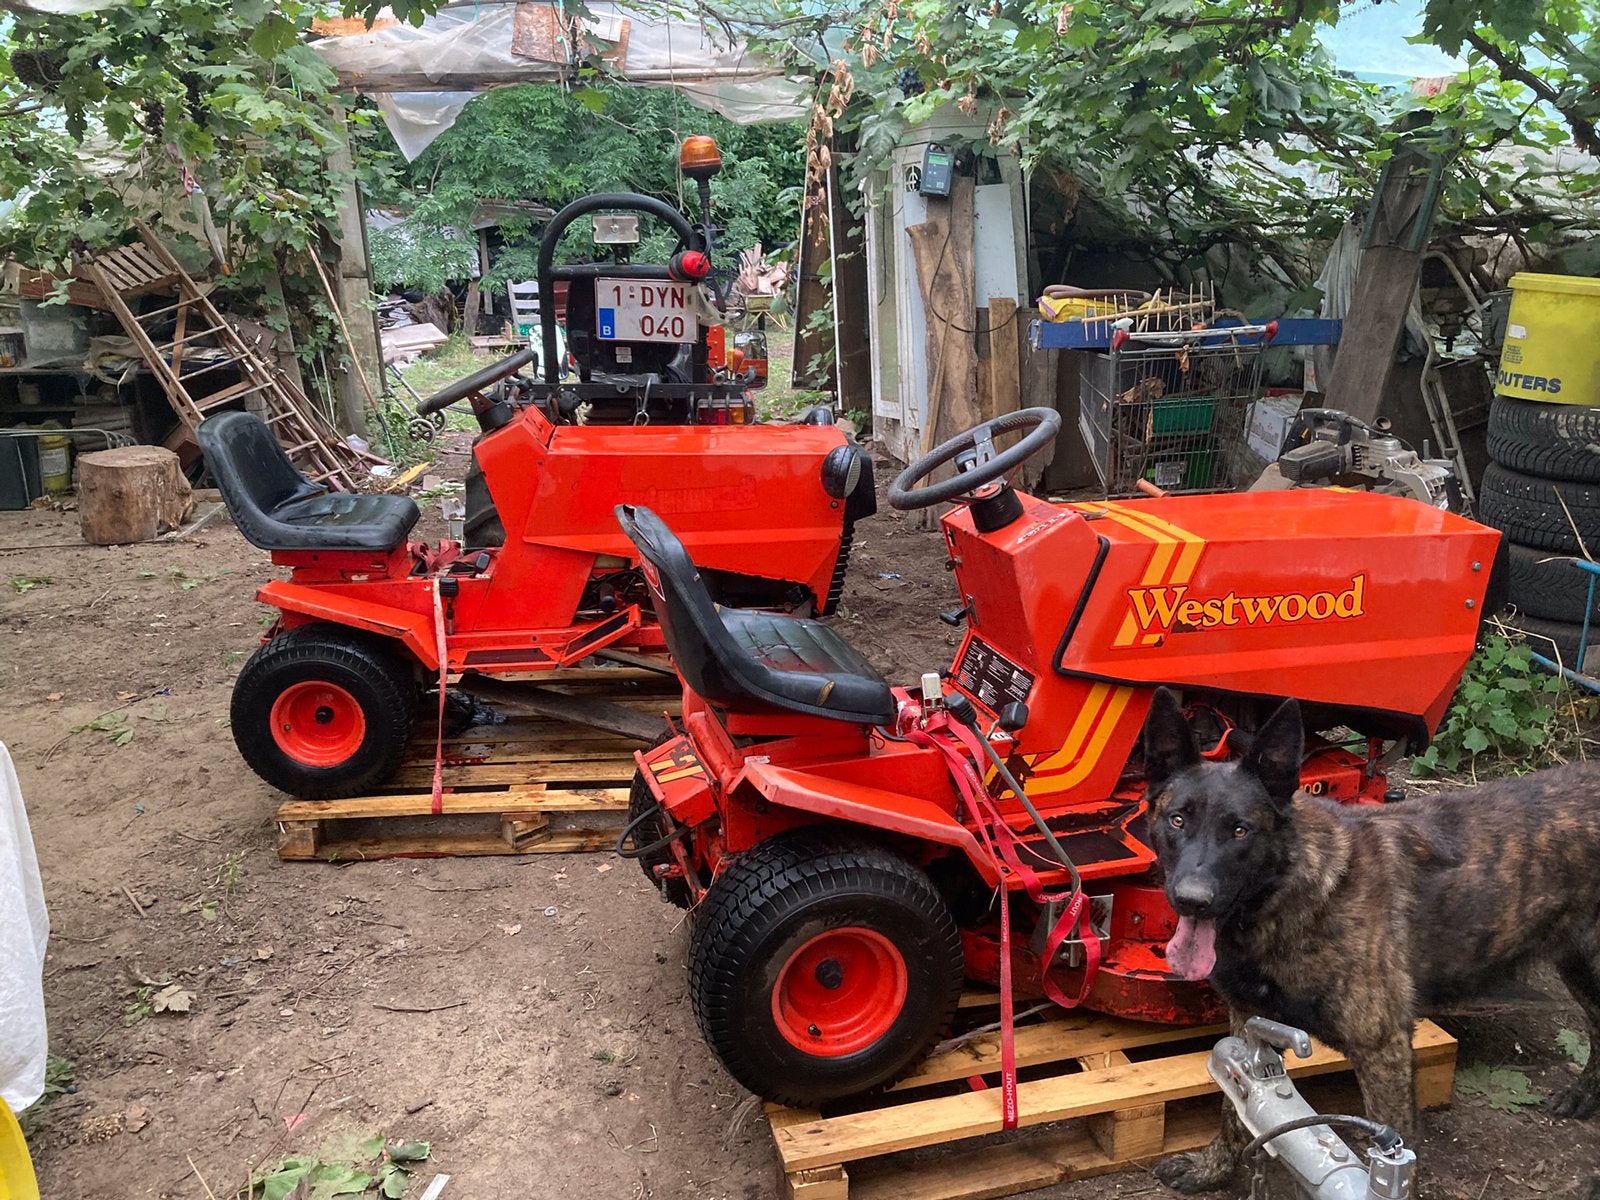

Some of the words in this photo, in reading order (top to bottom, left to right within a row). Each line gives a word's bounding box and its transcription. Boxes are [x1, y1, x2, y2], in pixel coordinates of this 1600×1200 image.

[602, 325, 612, 336] B
[641, 315, 684, 338] 040
[1127, 573, 1366, 630] Westwood
[1300, 781, 1322, 795] 00
[1005, 1072, 1015, 1123] MEZO-HOUT
